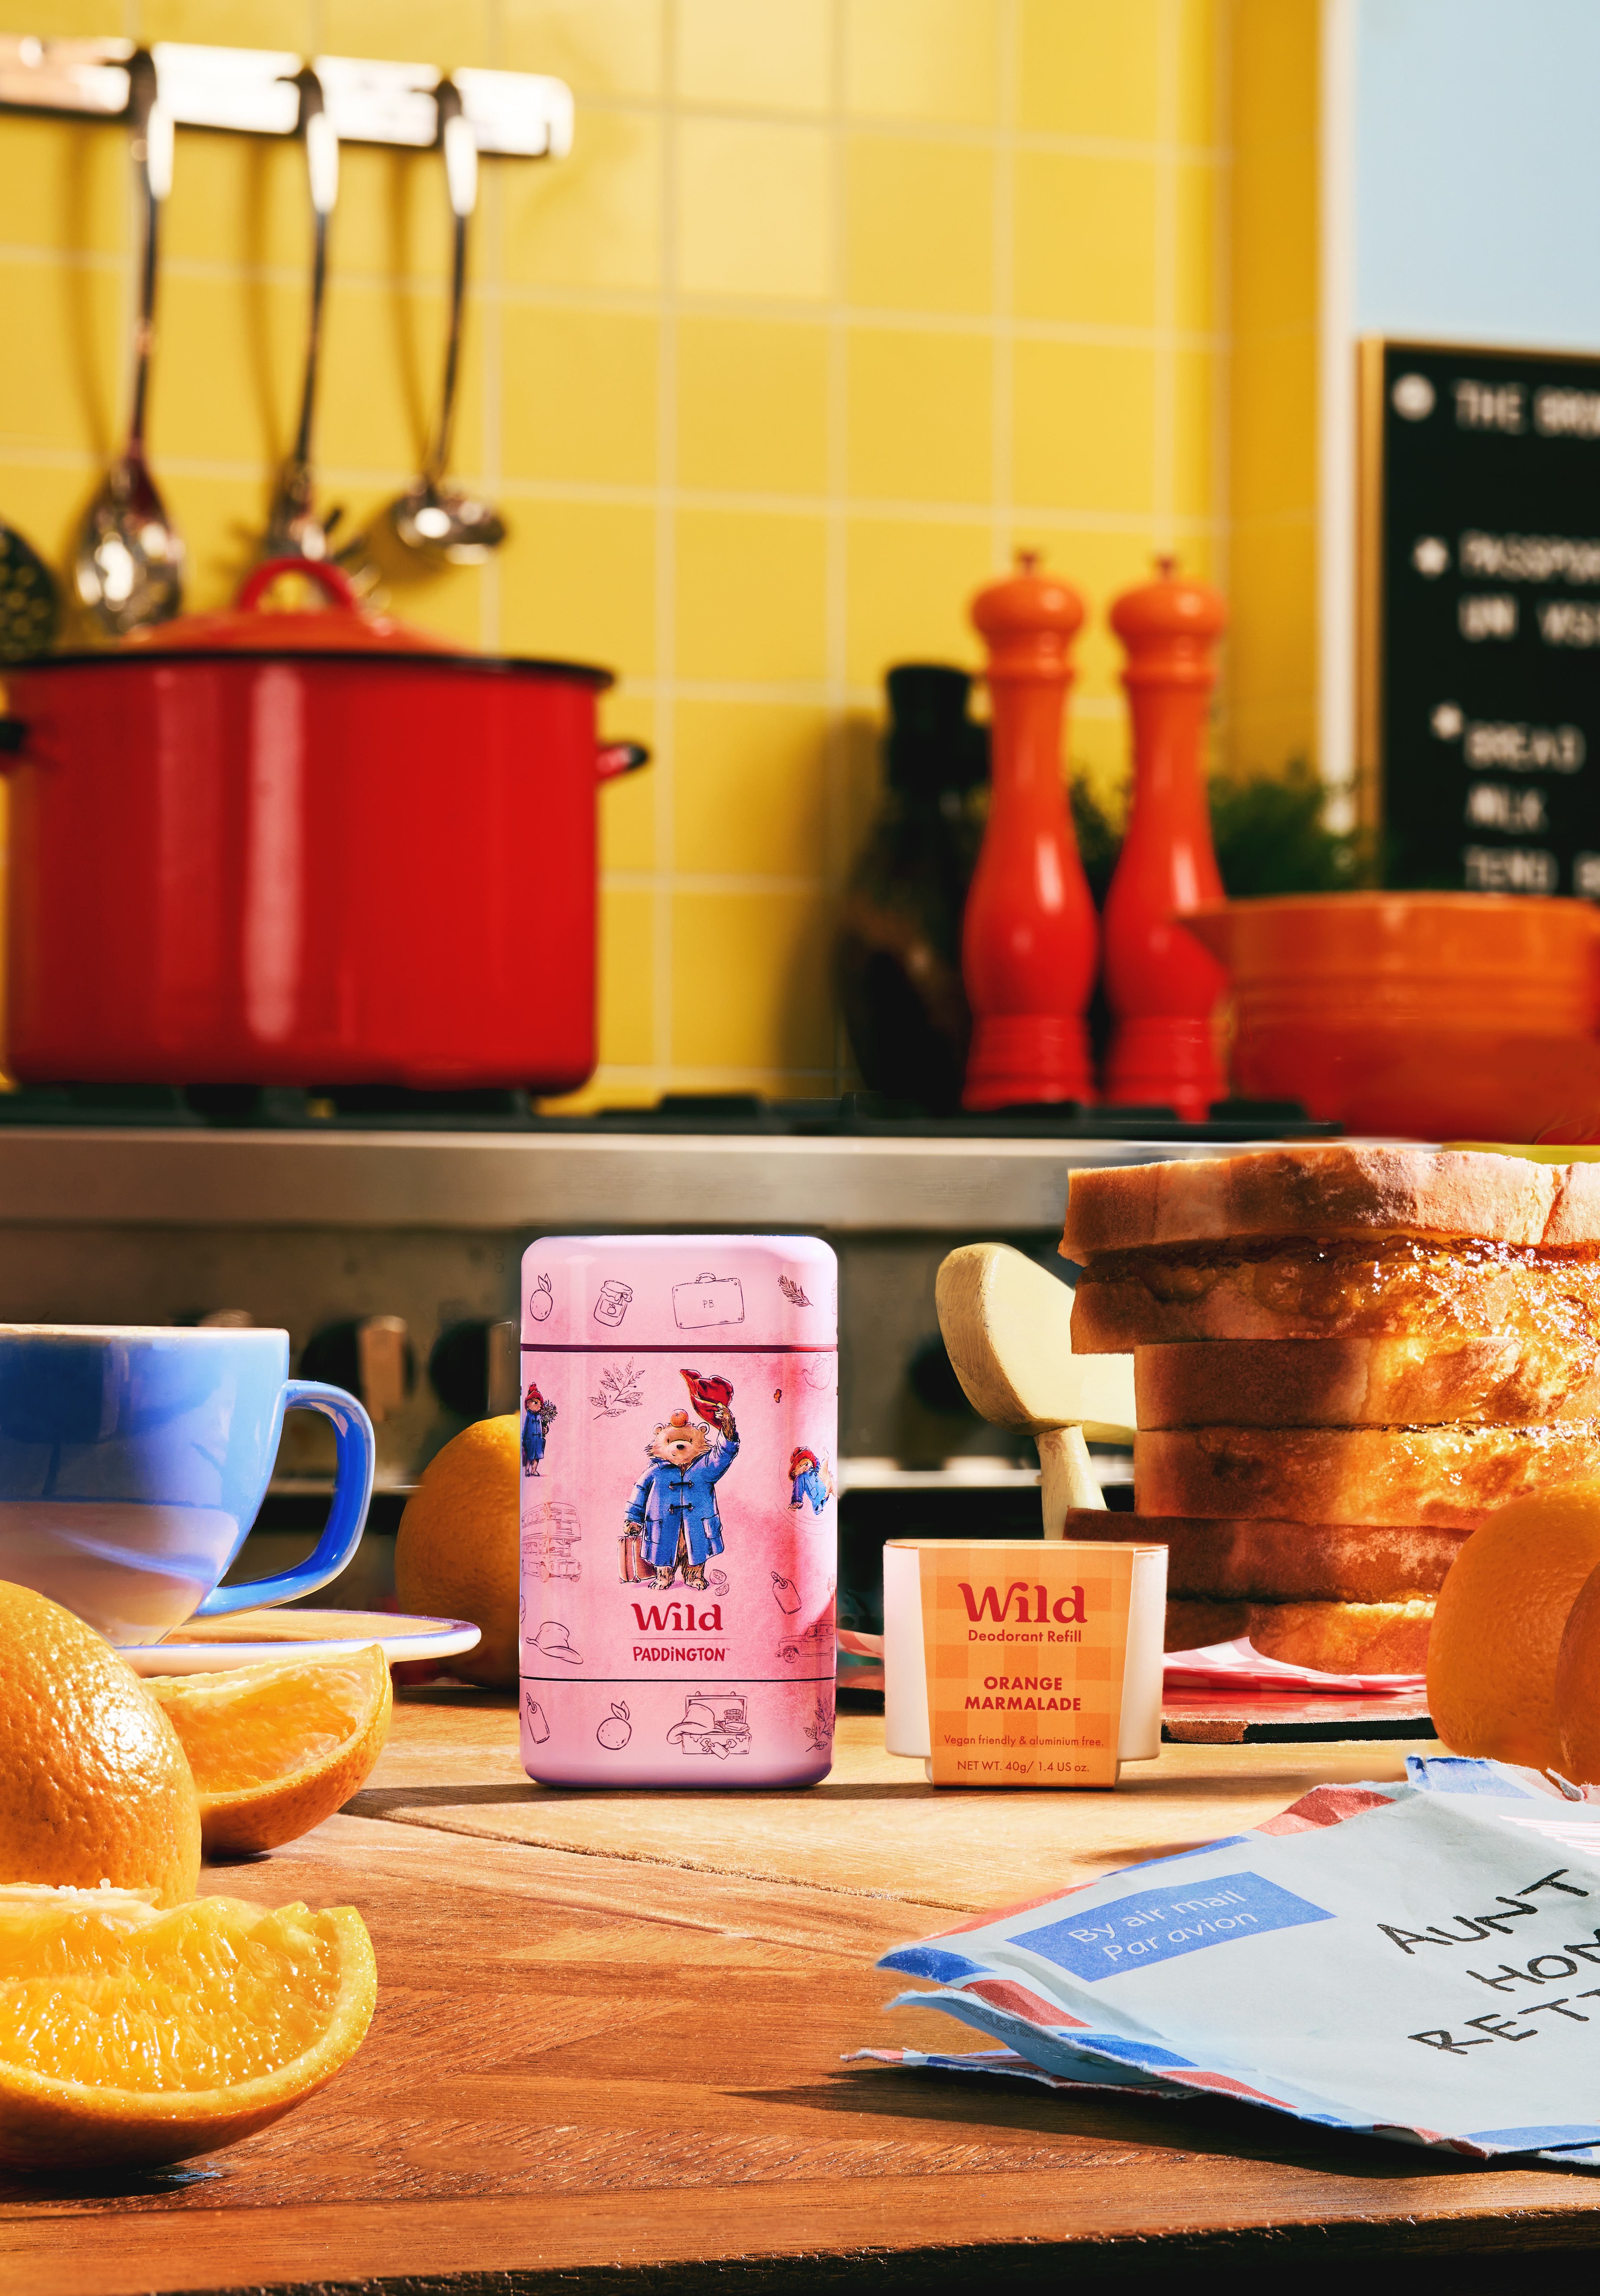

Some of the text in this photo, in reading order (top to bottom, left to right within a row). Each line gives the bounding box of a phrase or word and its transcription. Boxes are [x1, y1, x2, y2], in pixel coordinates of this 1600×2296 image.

[957, 1582, 1088, 1624] Wild
[631, 1602, 724, 1631] Wild
[969, 1629, 1082, 1642] Deodorant Refill
[984, 1676, 1062, 1691] ORANGE
[965, 1697, 1081, 1711] MARMALADE
[944, 1734, 1104, 1747] Vegan friendly & aluminium free.
[958, 1761, 979, 1770] NET
[982, 1762, 1002, 1771] WT.
[1005, 1761, 1034, 1773] 40g/
[1039, 1762, 1054, 1771] 1.4
[1058, 1763, 1072, 1772] US
[1067, 1890, 1247, 1943] By air mail
[1377, 1868, 1589, 1954] AUNT
[1102, 1912, 1259, 1961] Par avion
